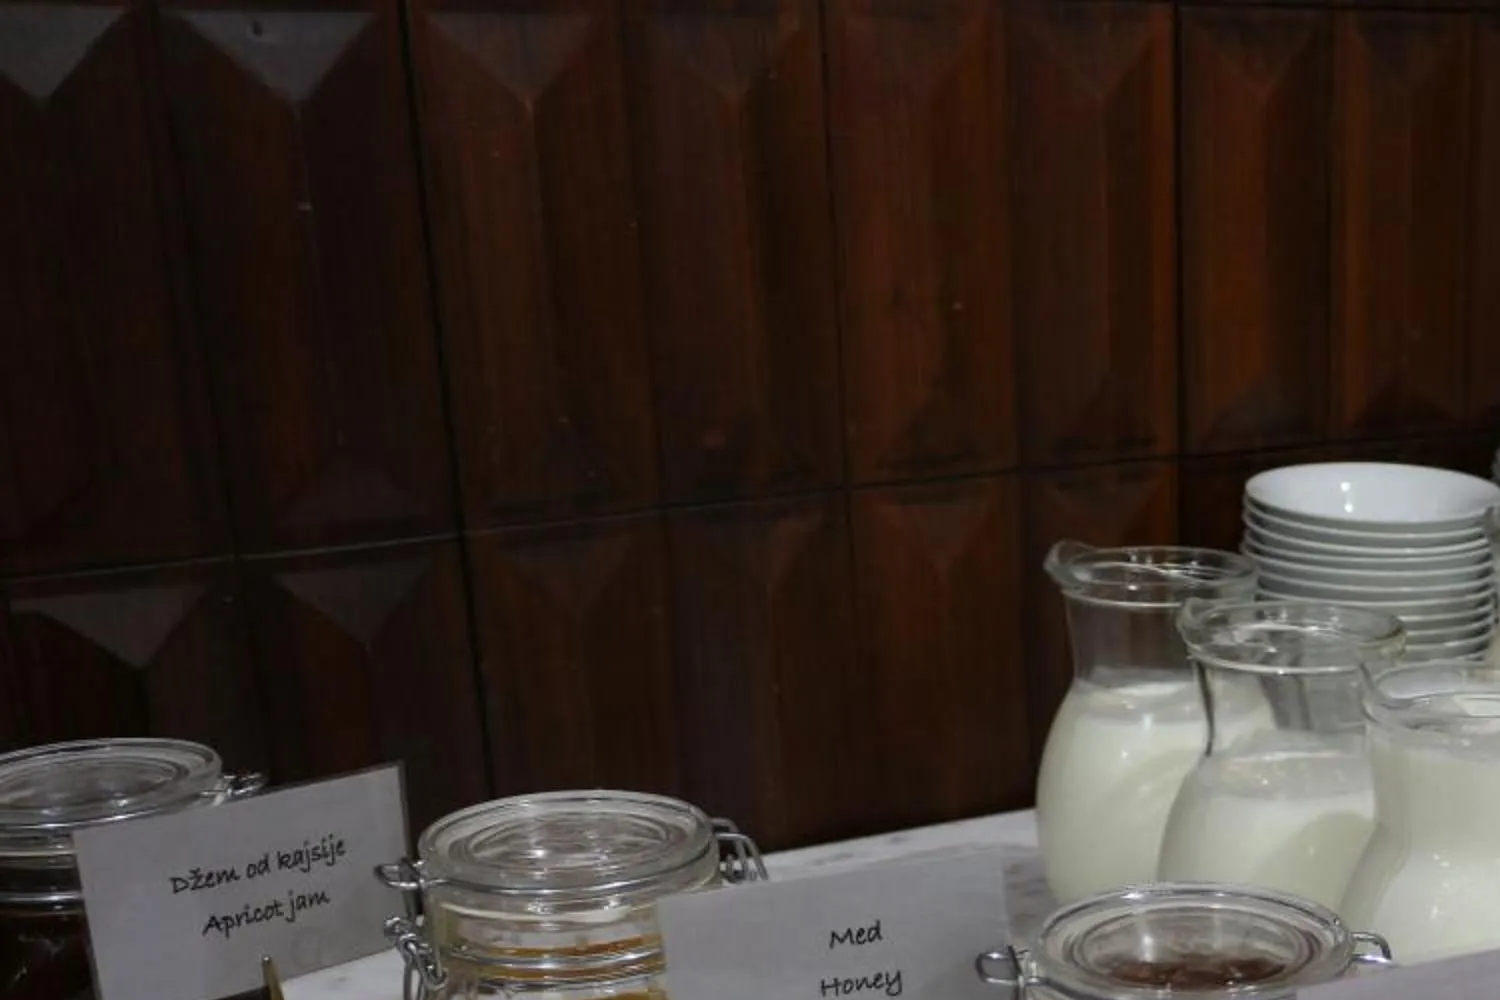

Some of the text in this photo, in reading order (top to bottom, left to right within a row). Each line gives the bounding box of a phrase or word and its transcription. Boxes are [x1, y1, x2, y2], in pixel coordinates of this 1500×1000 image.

[169, 834, 346, 894] Džem od kajsije
[202, 890, 331, 938] Apricot jam
[829, 919, 883, 949] Med
[820, 970, 902, 997] Honey
